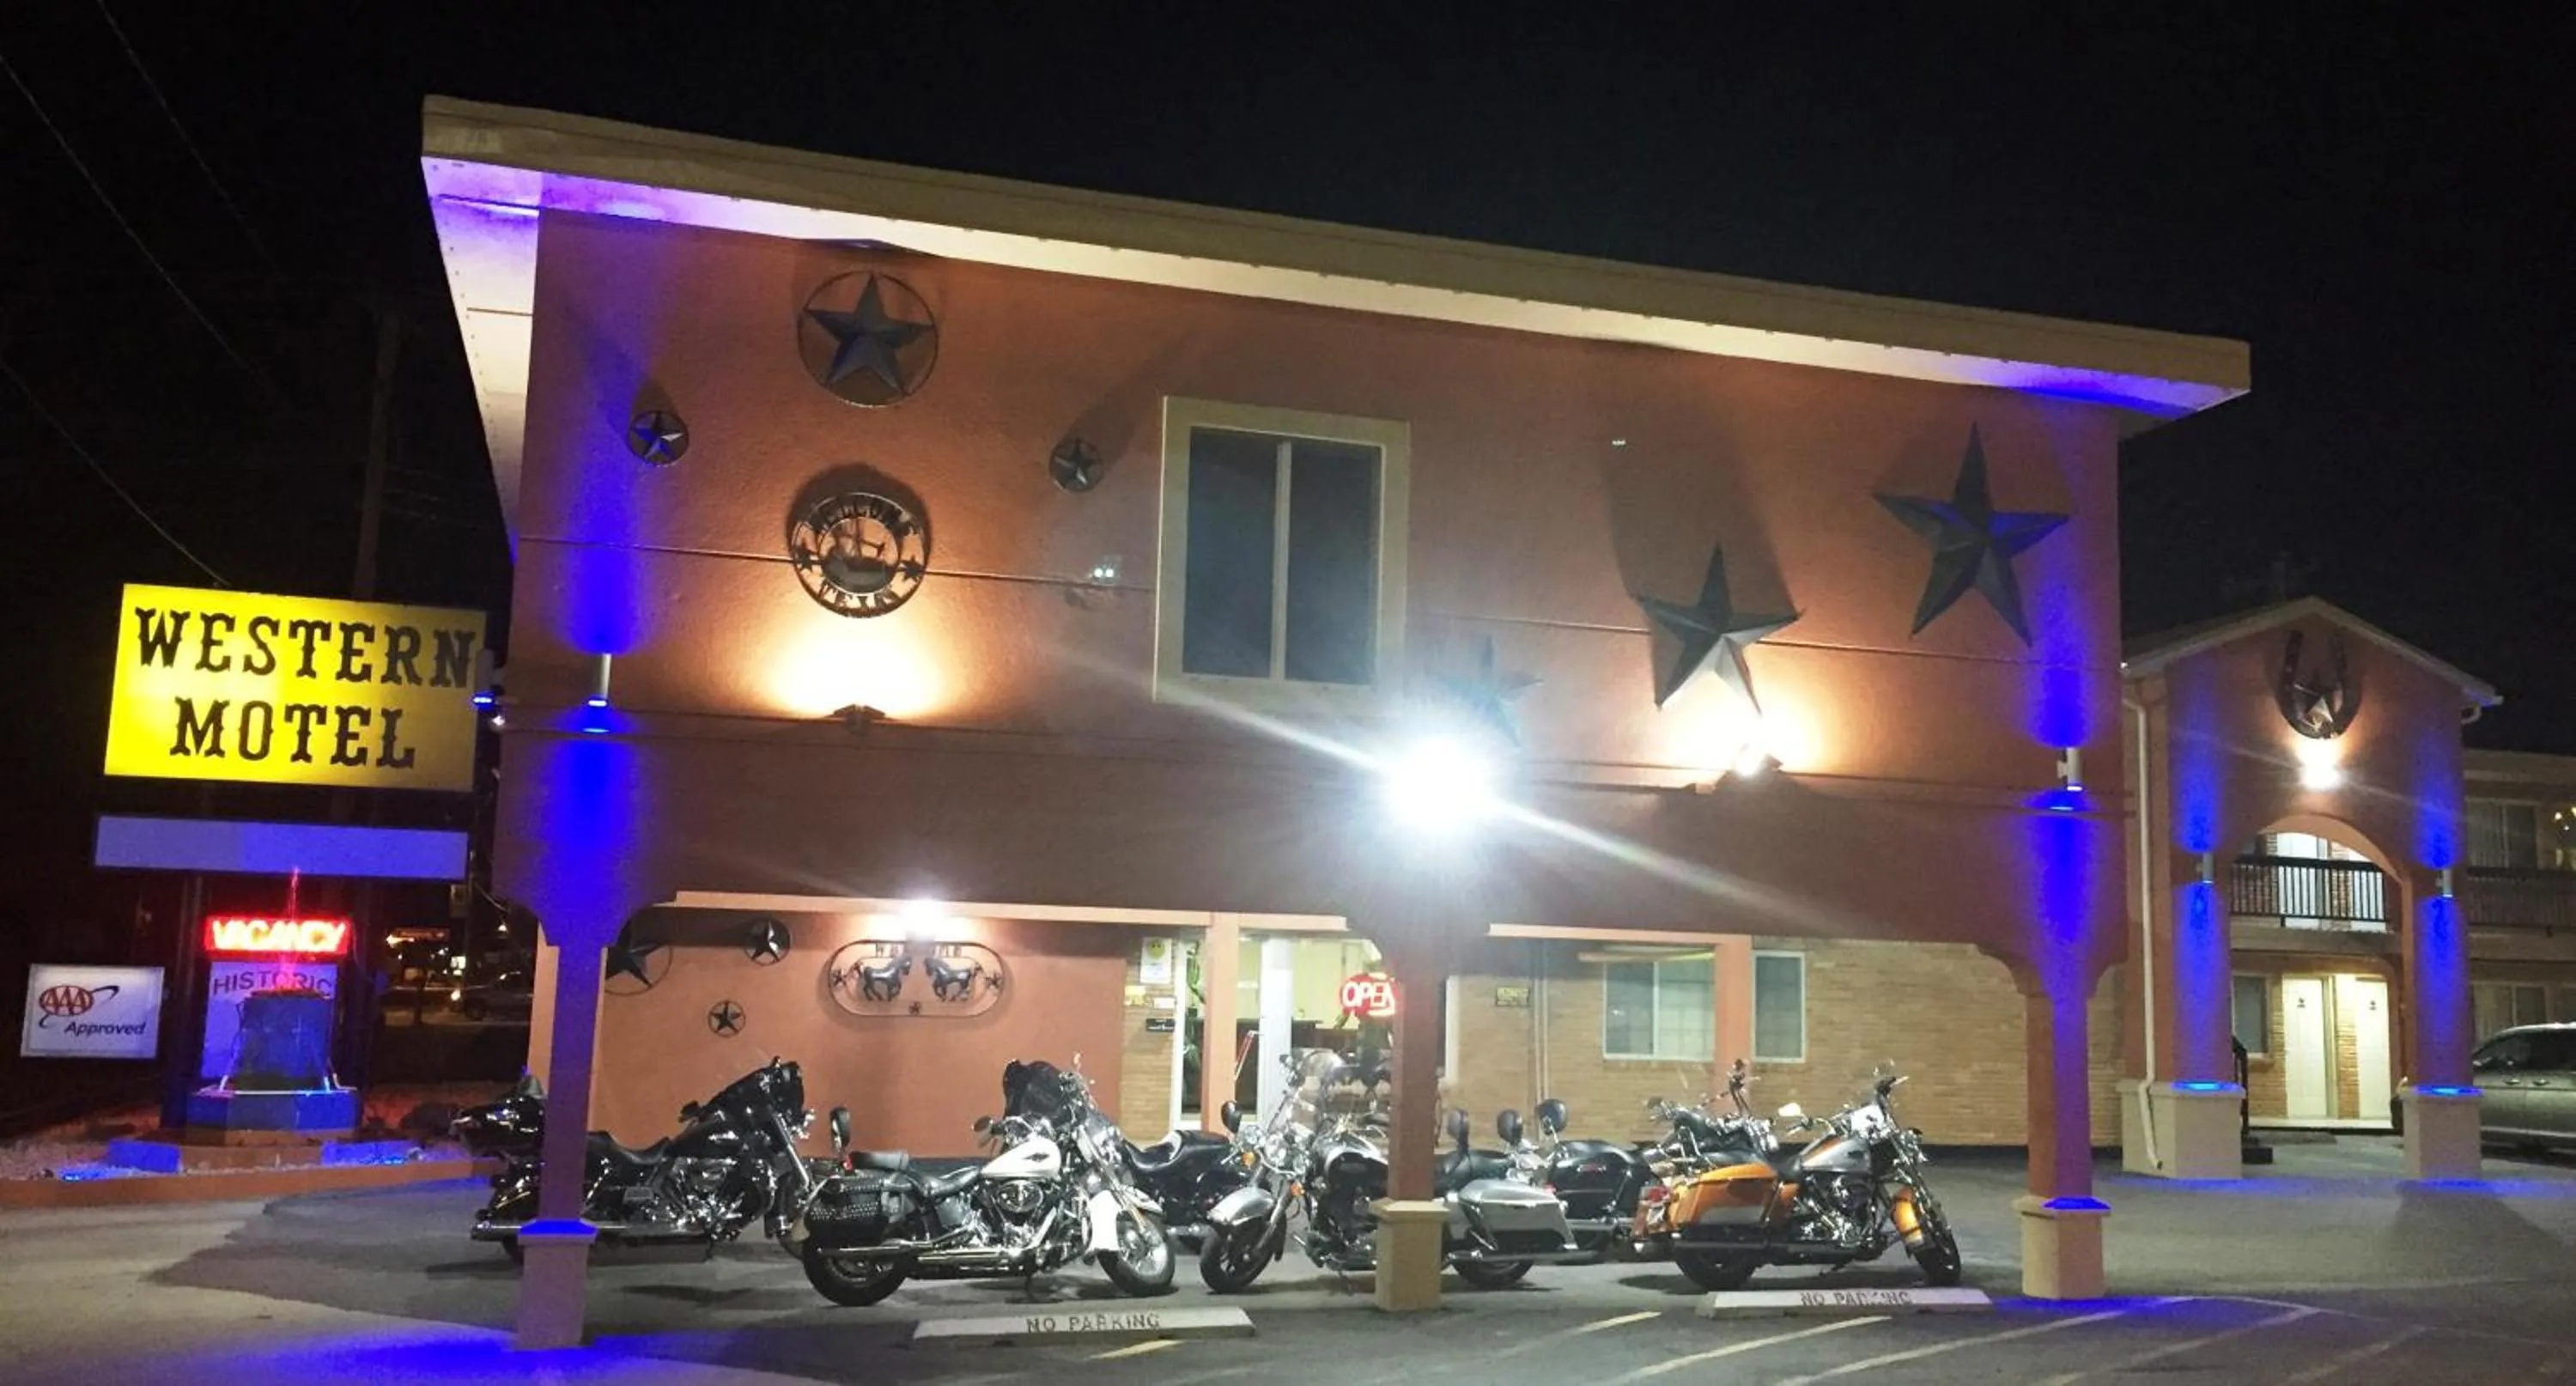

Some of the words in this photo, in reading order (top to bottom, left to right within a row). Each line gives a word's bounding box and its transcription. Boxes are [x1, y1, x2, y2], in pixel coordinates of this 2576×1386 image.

[135, 606, 476, 688] WESTERN
[169, 696, 416, 769] MOTEL
[212, 920, 346, 951] VACANCY
[213, 971, 332, 997] HISTORIC
[44, 987, 88, 1016] AAA
[64, 1021, 146, 1036] Approved
[1801, 1292, 1825, 1305] NO
[1026, 1316, 1056, 1333] NO
[1068, 1312, 1161, 1332] PARKING
